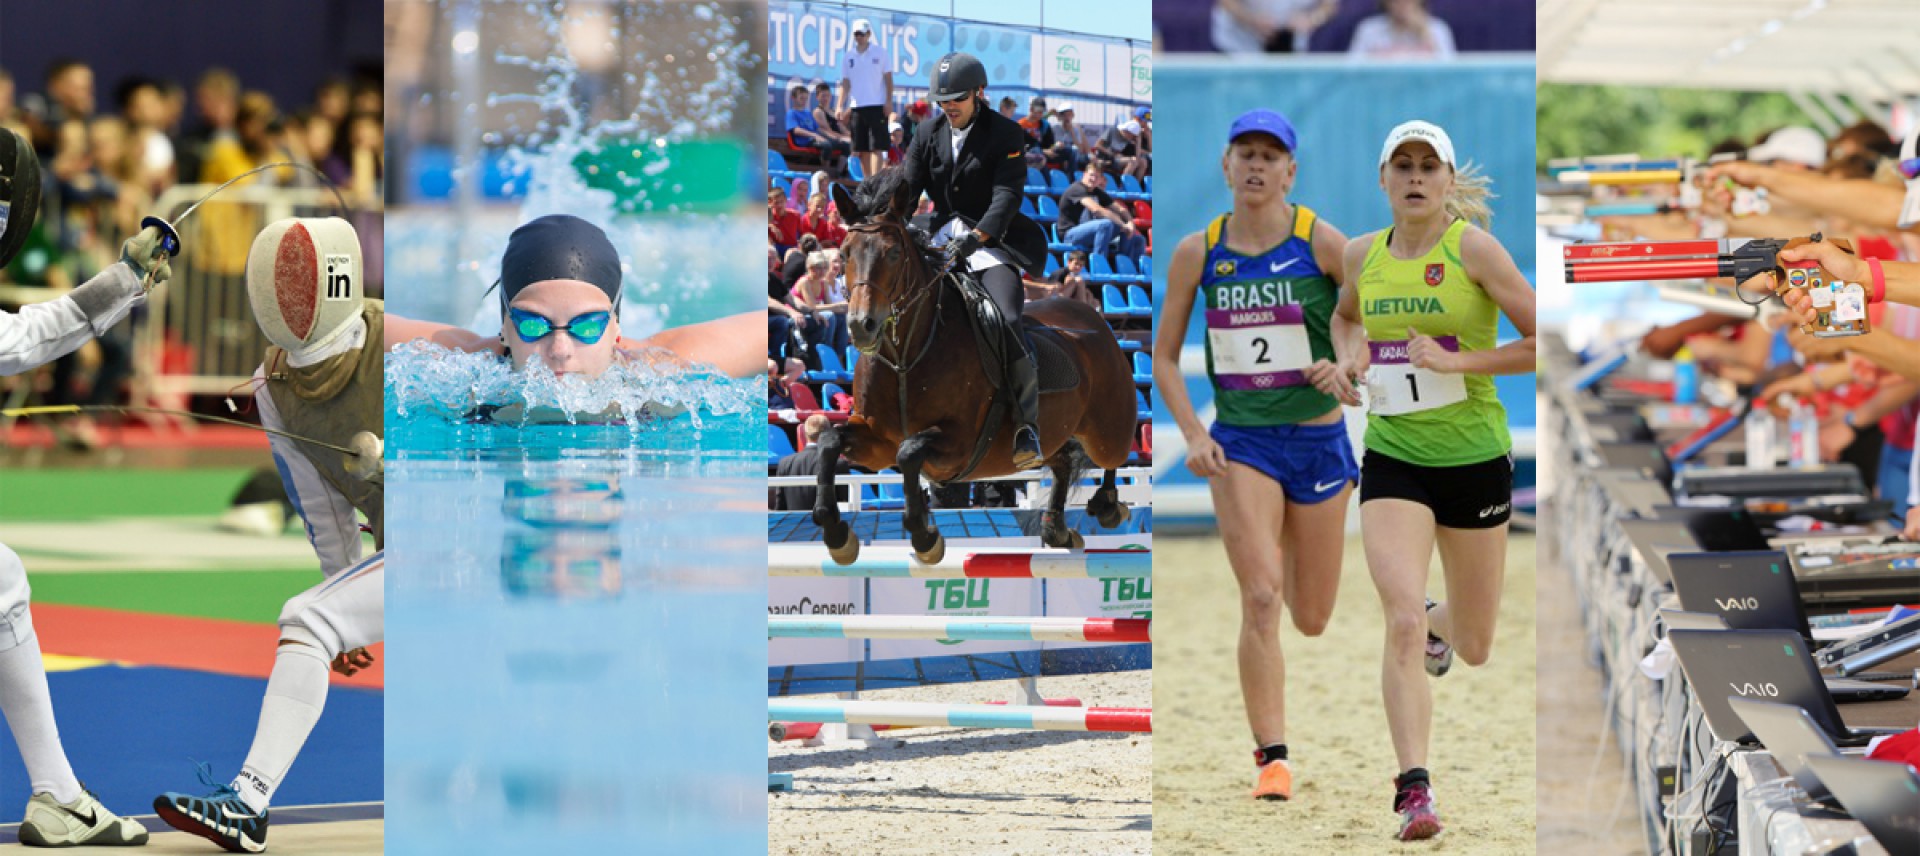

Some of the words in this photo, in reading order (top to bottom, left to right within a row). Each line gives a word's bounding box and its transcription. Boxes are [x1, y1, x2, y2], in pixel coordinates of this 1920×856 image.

[767, 12, 919, 76] TICIPANTS
[327, 265, 350, 298] in
[1216, 280, 1300, 311] BRASIL
[1364, 297, 1444, 316] LIETUVA
[1251, 336, 1272, 365] 2
[1405, 373, 1420, 402] 1
[1714, 597, 1760, 611] VAIO
[1729, 682, 1779, 697] VAIO
